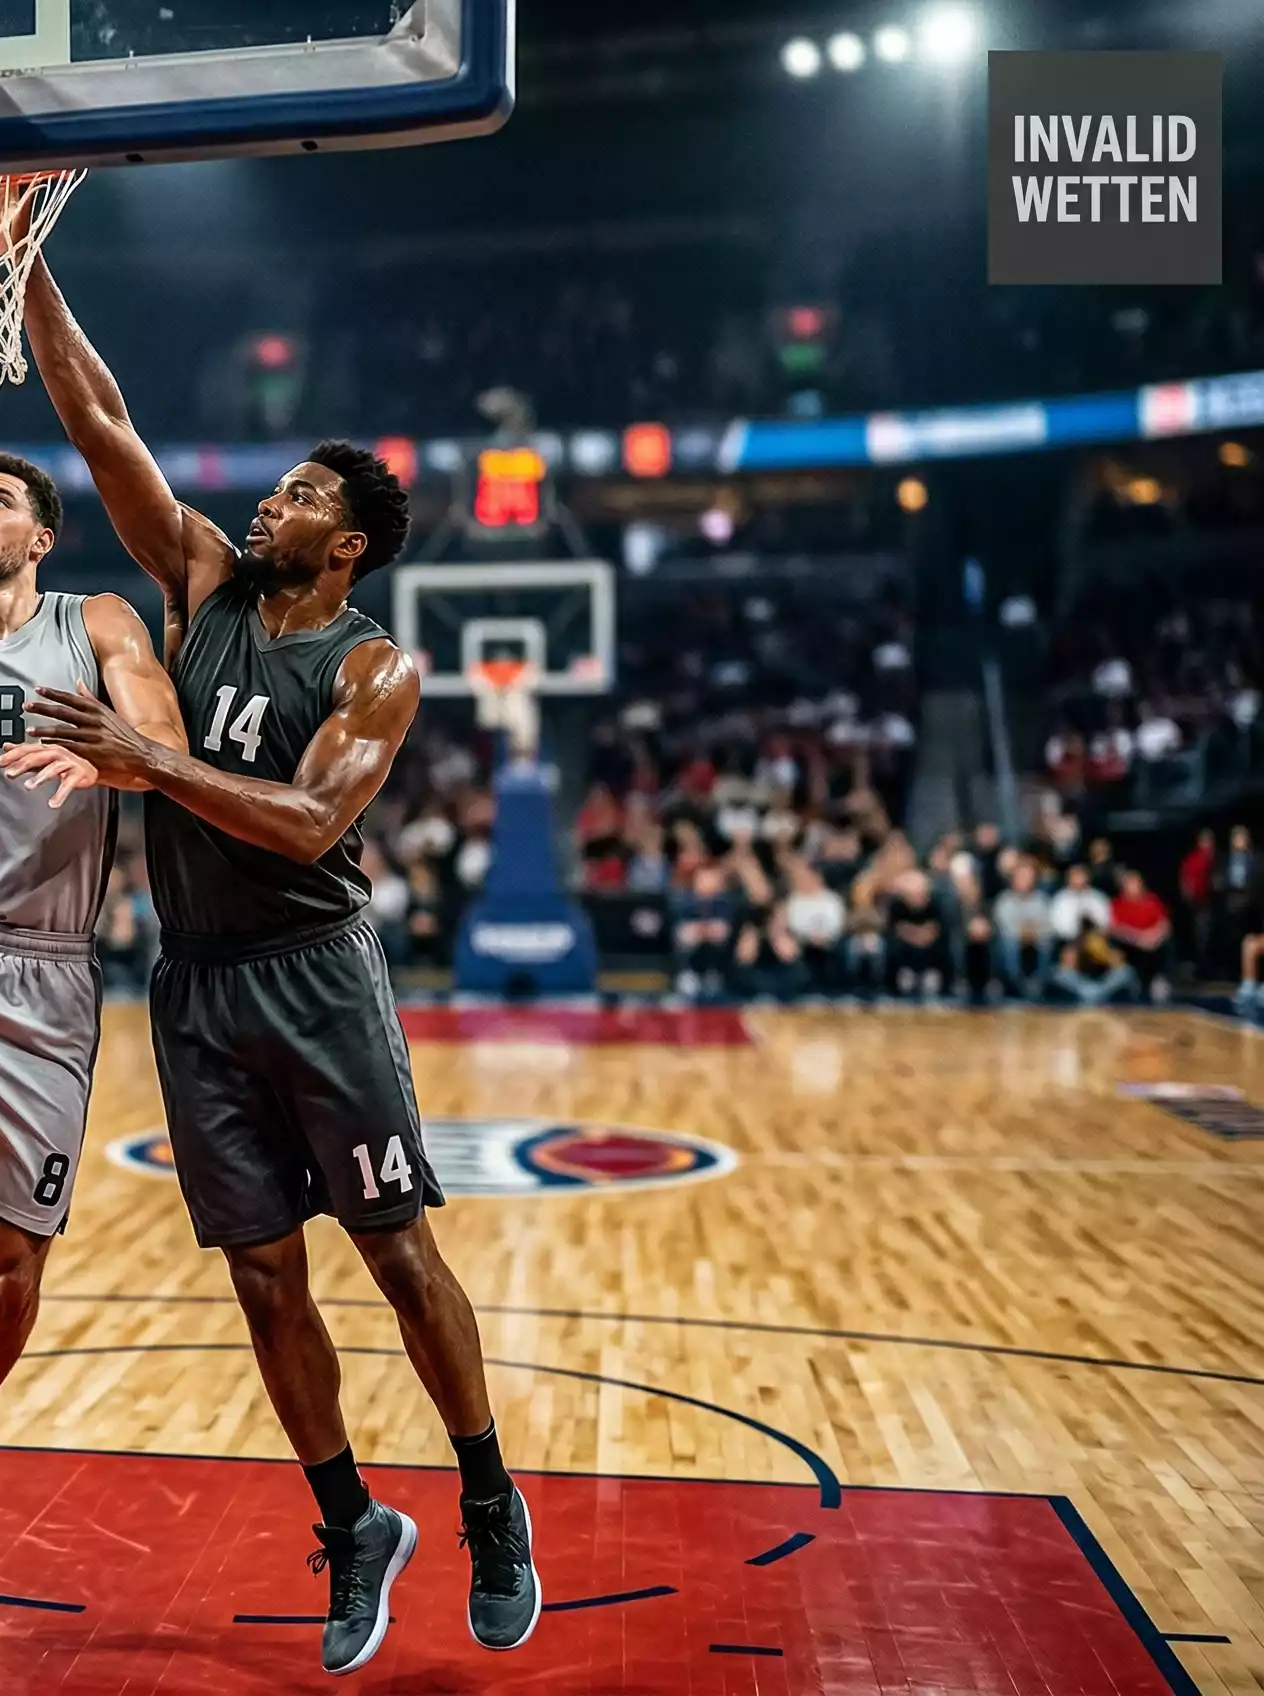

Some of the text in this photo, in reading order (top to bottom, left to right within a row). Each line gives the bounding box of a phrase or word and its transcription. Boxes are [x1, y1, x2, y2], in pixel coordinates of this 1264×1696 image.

[203, 684, 271, 763] 14
[33, 1152, 70, 1206] 8
[351, 1134, 412, 1200] 14
